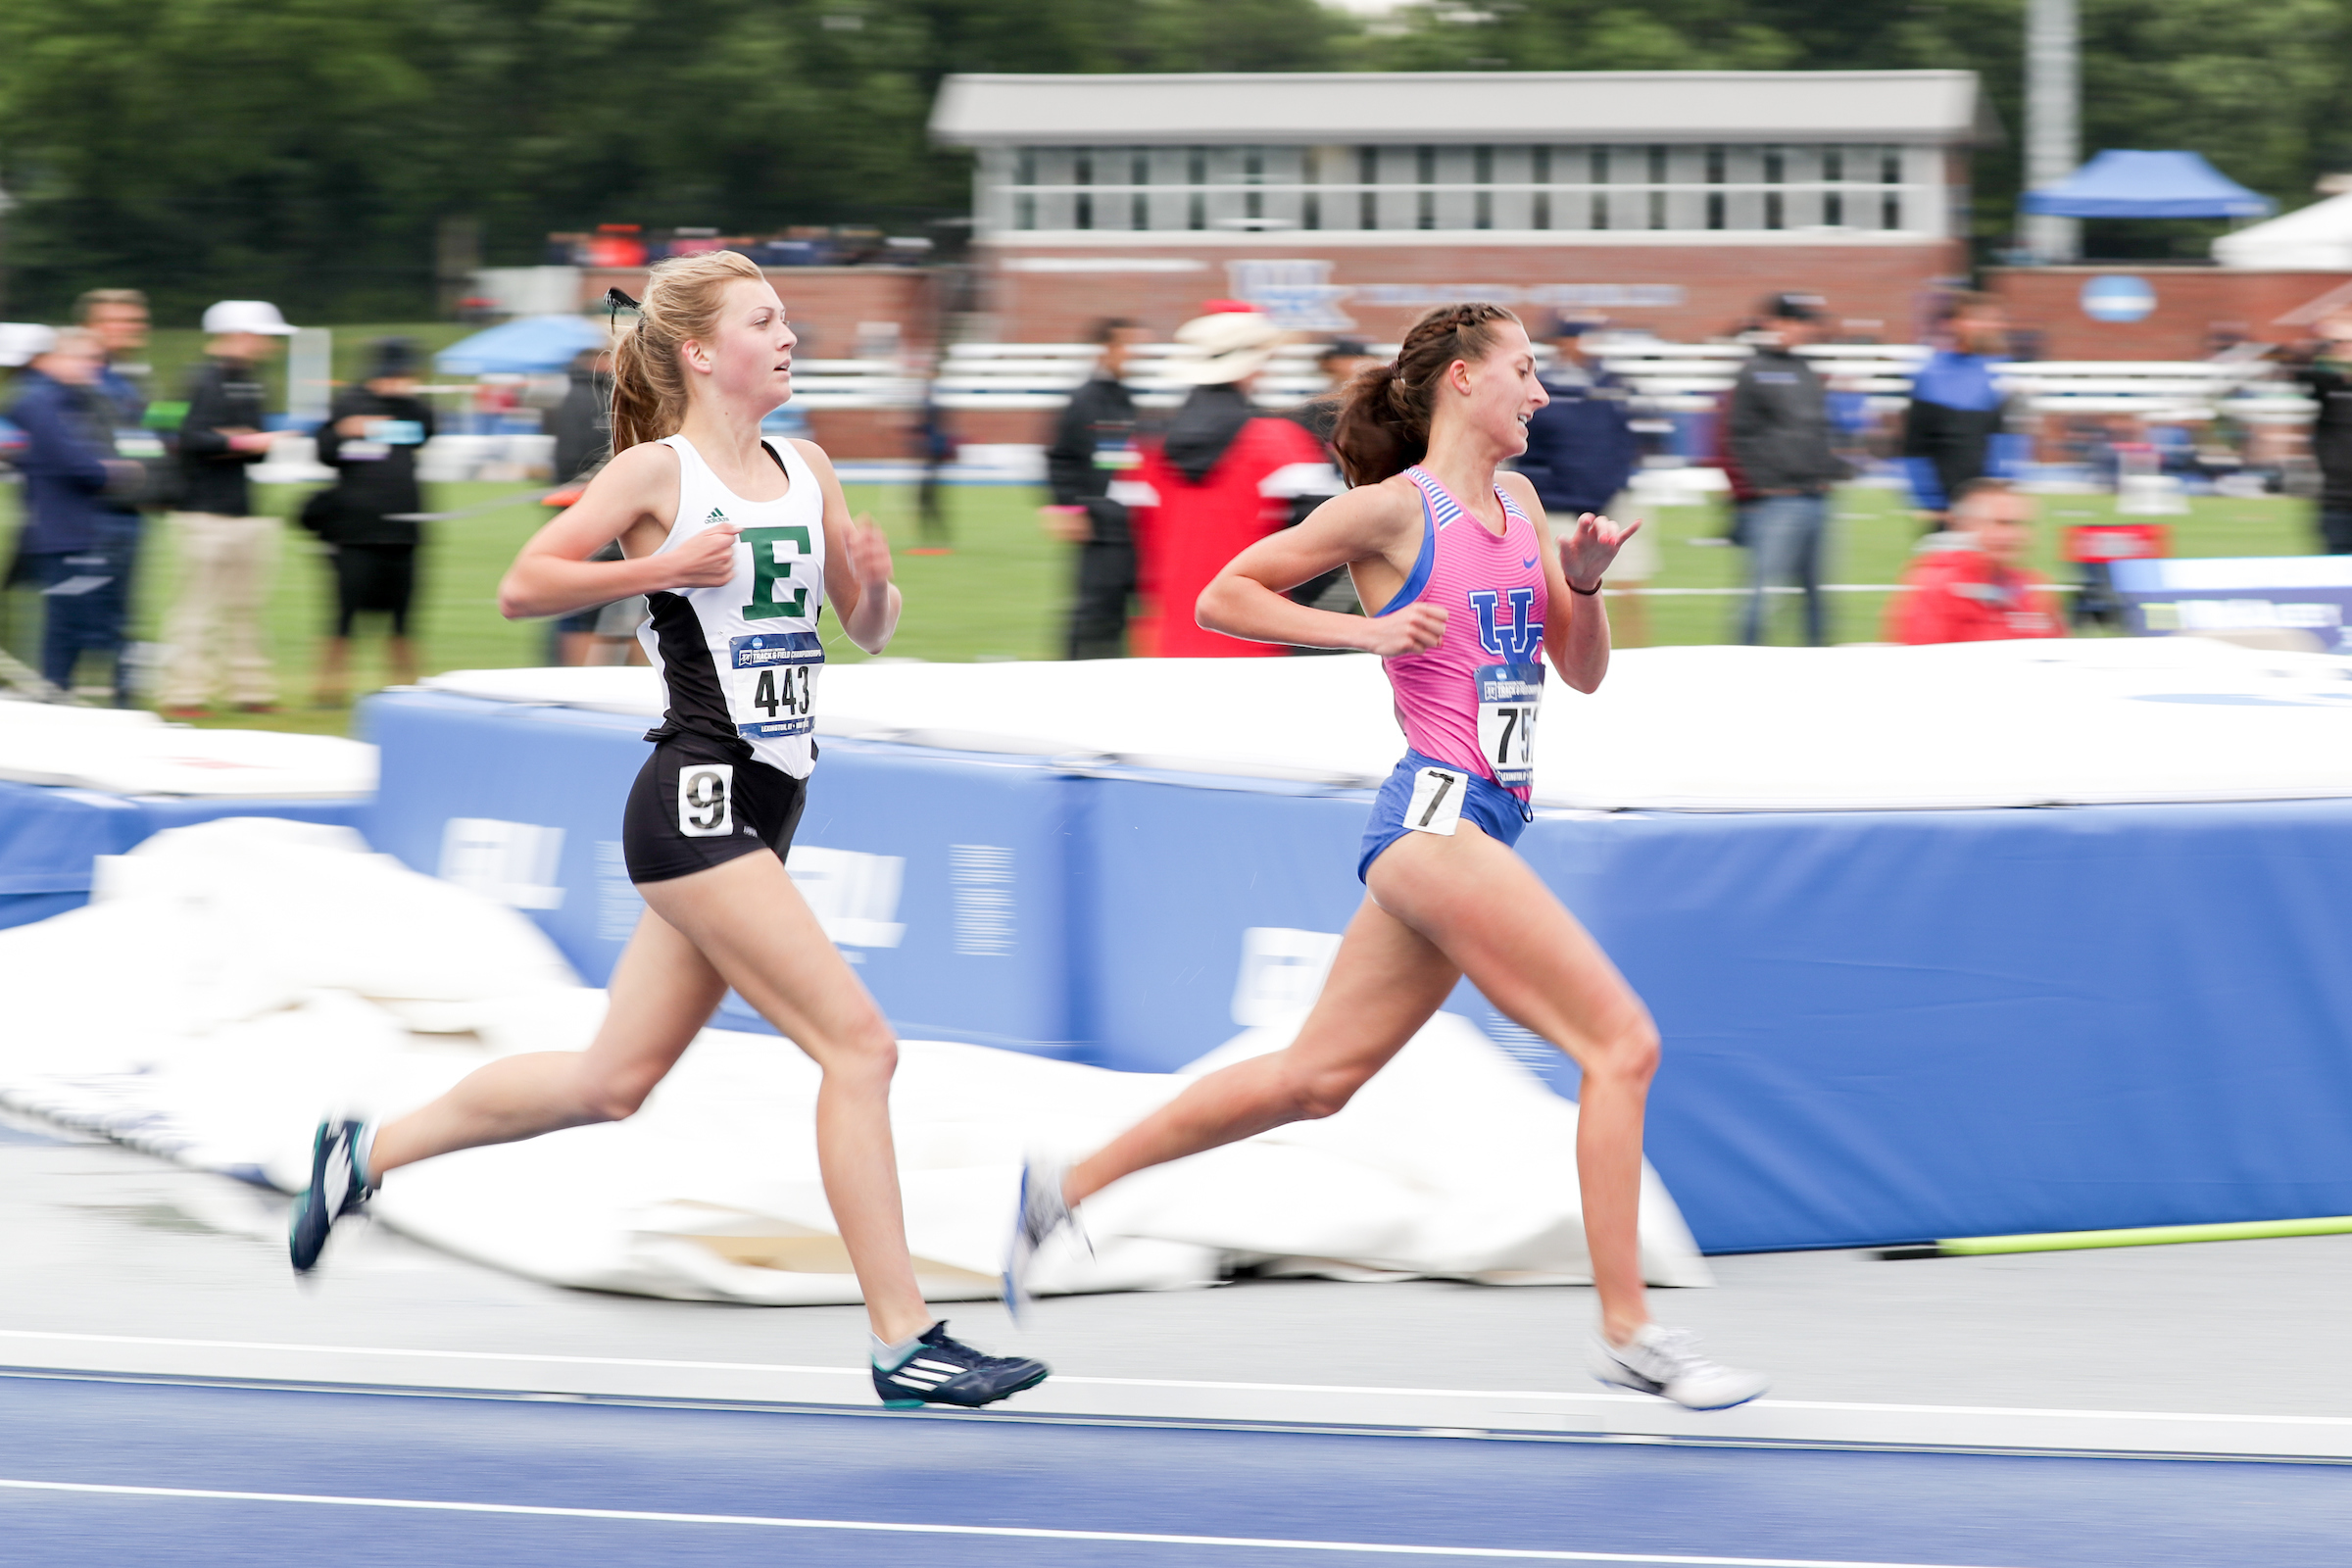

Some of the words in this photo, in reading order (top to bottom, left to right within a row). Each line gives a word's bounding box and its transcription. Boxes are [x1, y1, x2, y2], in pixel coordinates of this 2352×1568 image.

[739, 526, 811, 620] E
[753, 651, 772, 661] TRACK
[777, 650, 791, 660] FIELD
[754, 665, 809, 717] 443
[1497, 706, 1538, 763] 75
[686, 771, 725, 830] 9
[1417, 769, 1455, 827] 7
